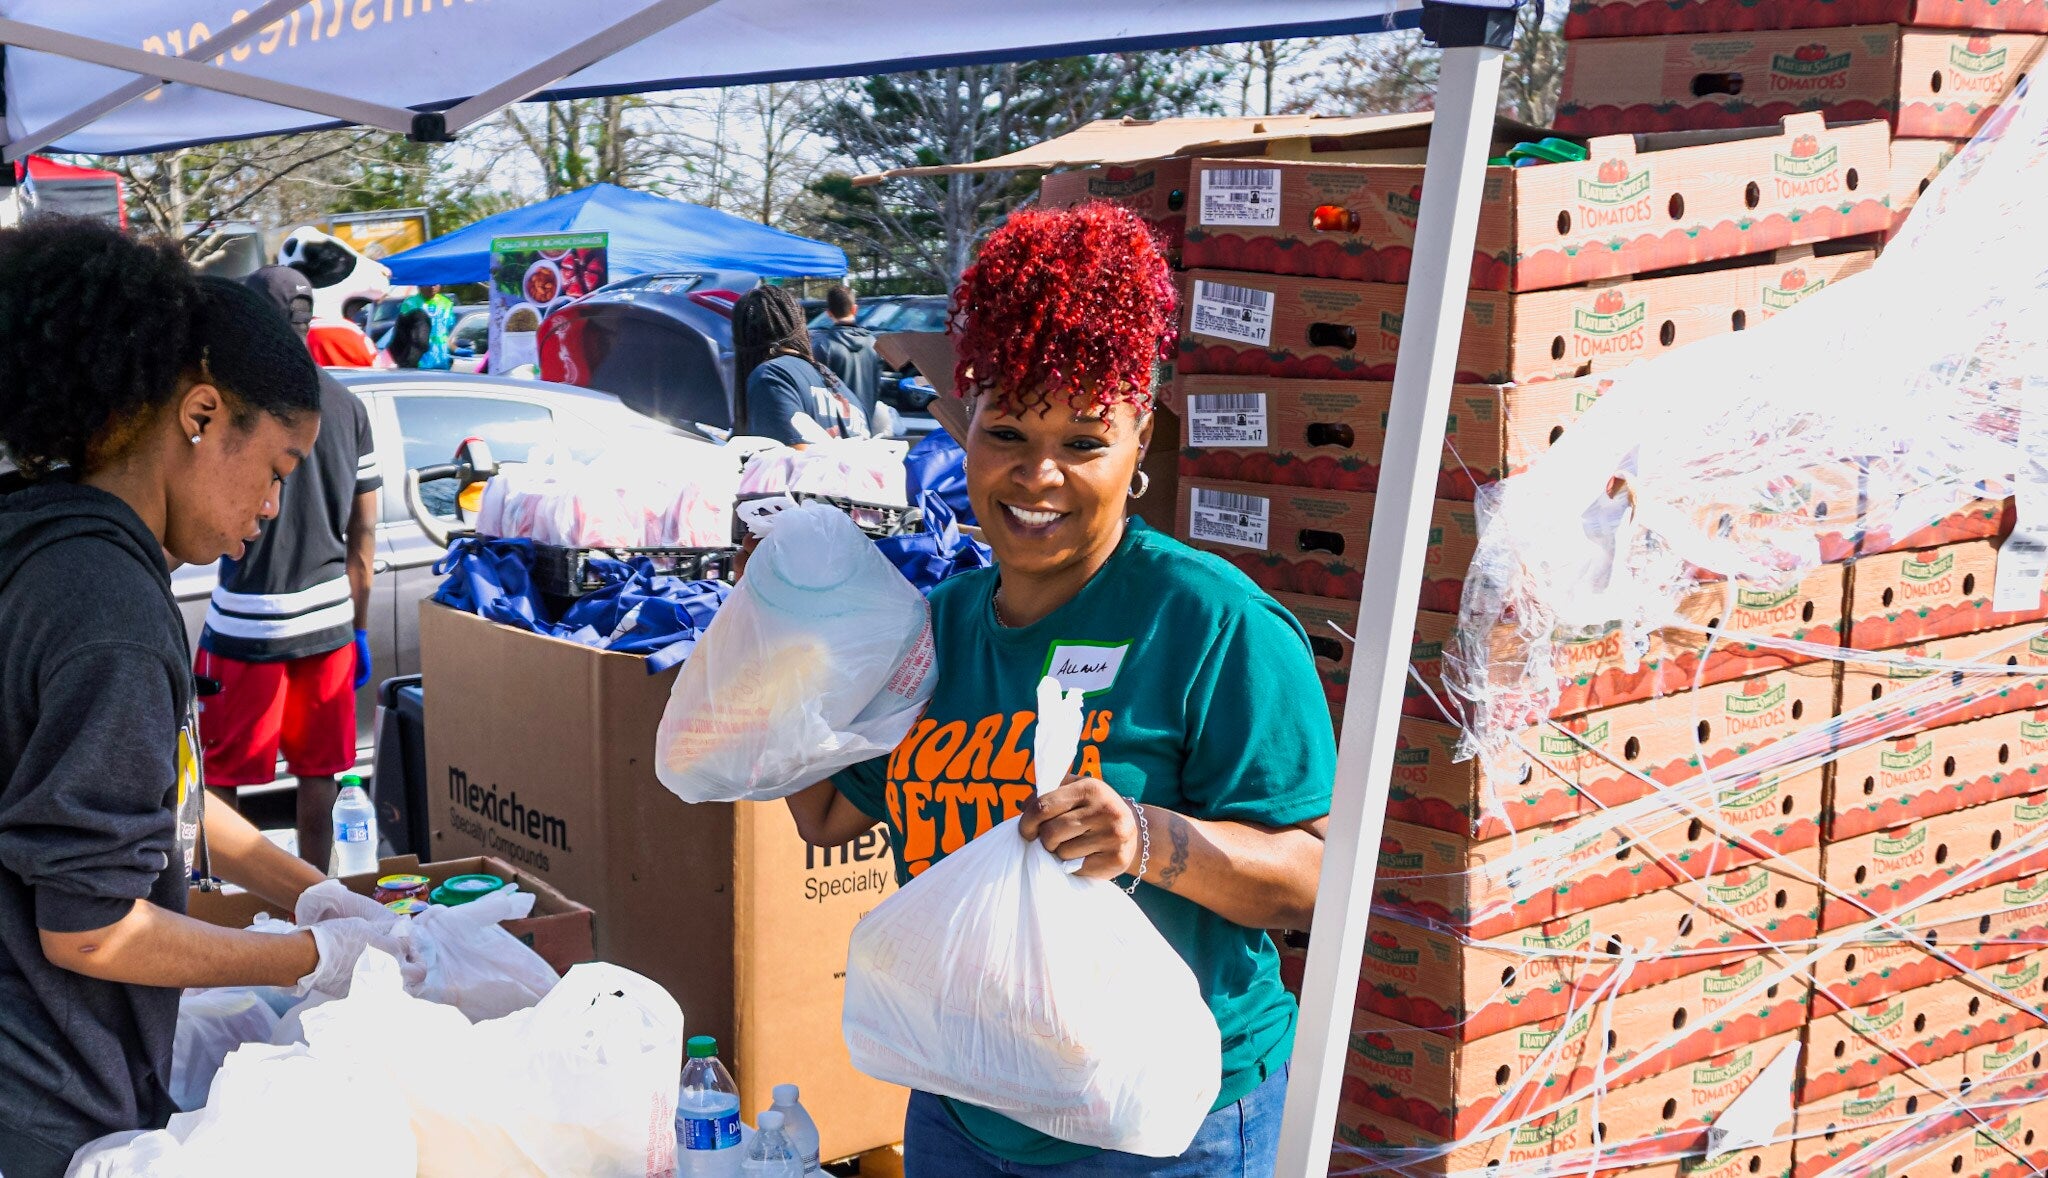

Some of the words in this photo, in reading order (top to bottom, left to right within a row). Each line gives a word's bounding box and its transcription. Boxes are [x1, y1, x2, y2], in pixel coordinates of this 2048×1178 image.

[1769, 72, 1847, 91] TOMATOES
[1774, 169, 1838, 199] TOMATOES
[1578, 195, 1650, 229] TOMATOES
[1574, 326, 1644, 358] TOMATOES
[1736, 600, 1796, 630] TOMATOES
[1080, 709, 1113, 742] IS
[1726, 705, 1785, 736] TOMATOES
[1080, 744, 1103, 780] A
[449, 765, 567, 850] mexichem
[450, 806, 487, 848] Specialty
[489, 827, 550, 872] Compounds
[805, 869, 887, 903] Specialty
